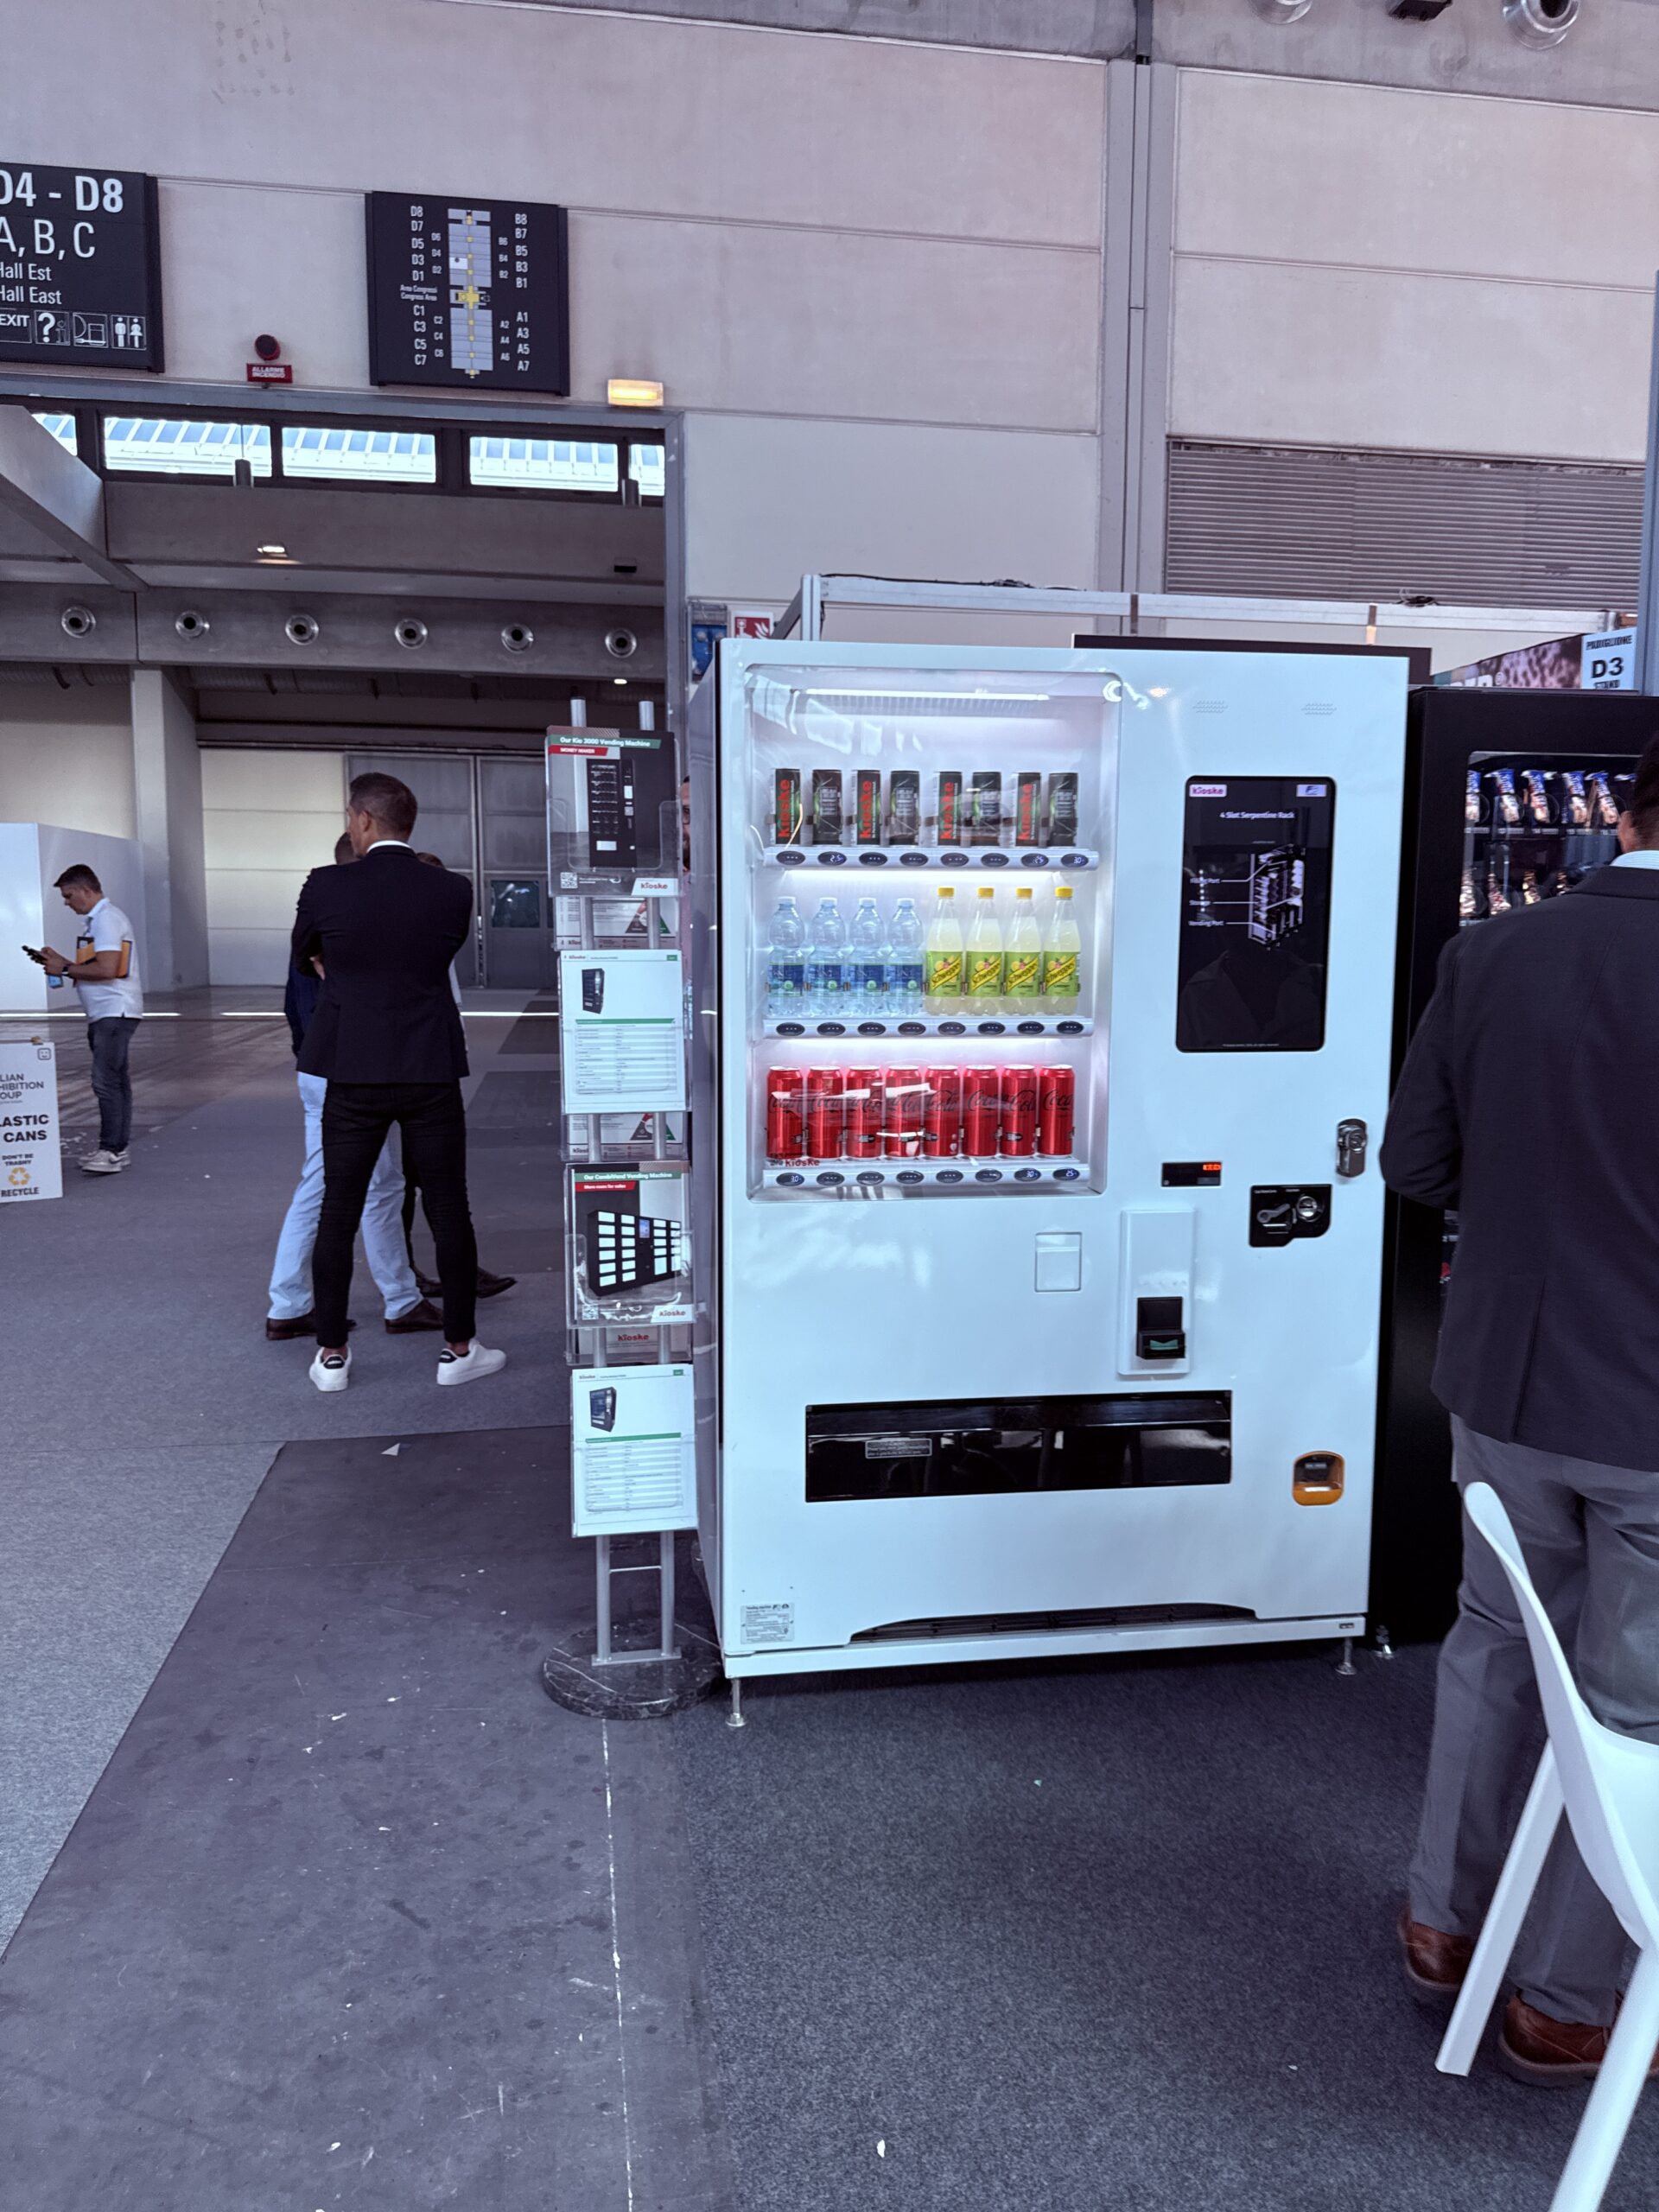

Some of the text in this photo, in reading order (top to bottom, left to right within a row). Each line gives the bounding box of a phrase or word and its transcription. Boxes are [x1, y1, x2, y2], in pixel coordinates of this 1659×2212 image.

[75, 175, 124, 213] D8
[410, 206, 423, 217] D8
[515, 213, 527, 225] B8
[411, 220, 423, 232] D7
[515, 228, 527, 238] B7
[34, 219, 65, 260] B,
[73, 221, 96, 258] C
[411, 238, 424, 249] D5
[516, 245, 528, 257] B5
[412, 254, 424, 265] D3
[516, 261, 528, 272] B3
[28, 264, 52, 282] Est
[412, 270, 424, 281] D1
[516, 277, 528, 289] B1
[29, 286, 62, 305] East
[414, 305, 424, 315] C1
[517, 312, 528, 322] A1
[414, 321, 426, 332] C3
[517, 327, 530, 339] A3
[415, 339, 427, 350] C5
[517, 344, 530, 354] A5
[415, 354, 427, 365] C7
[518, 360, 530, 371] A7
[1591, 657, 1624, 678] D3
[3, 1129, 48, 1142] CANS
[1, 1186, 40, 1198] RECYCLE
[618, 1333, 650, 1342] kioske
